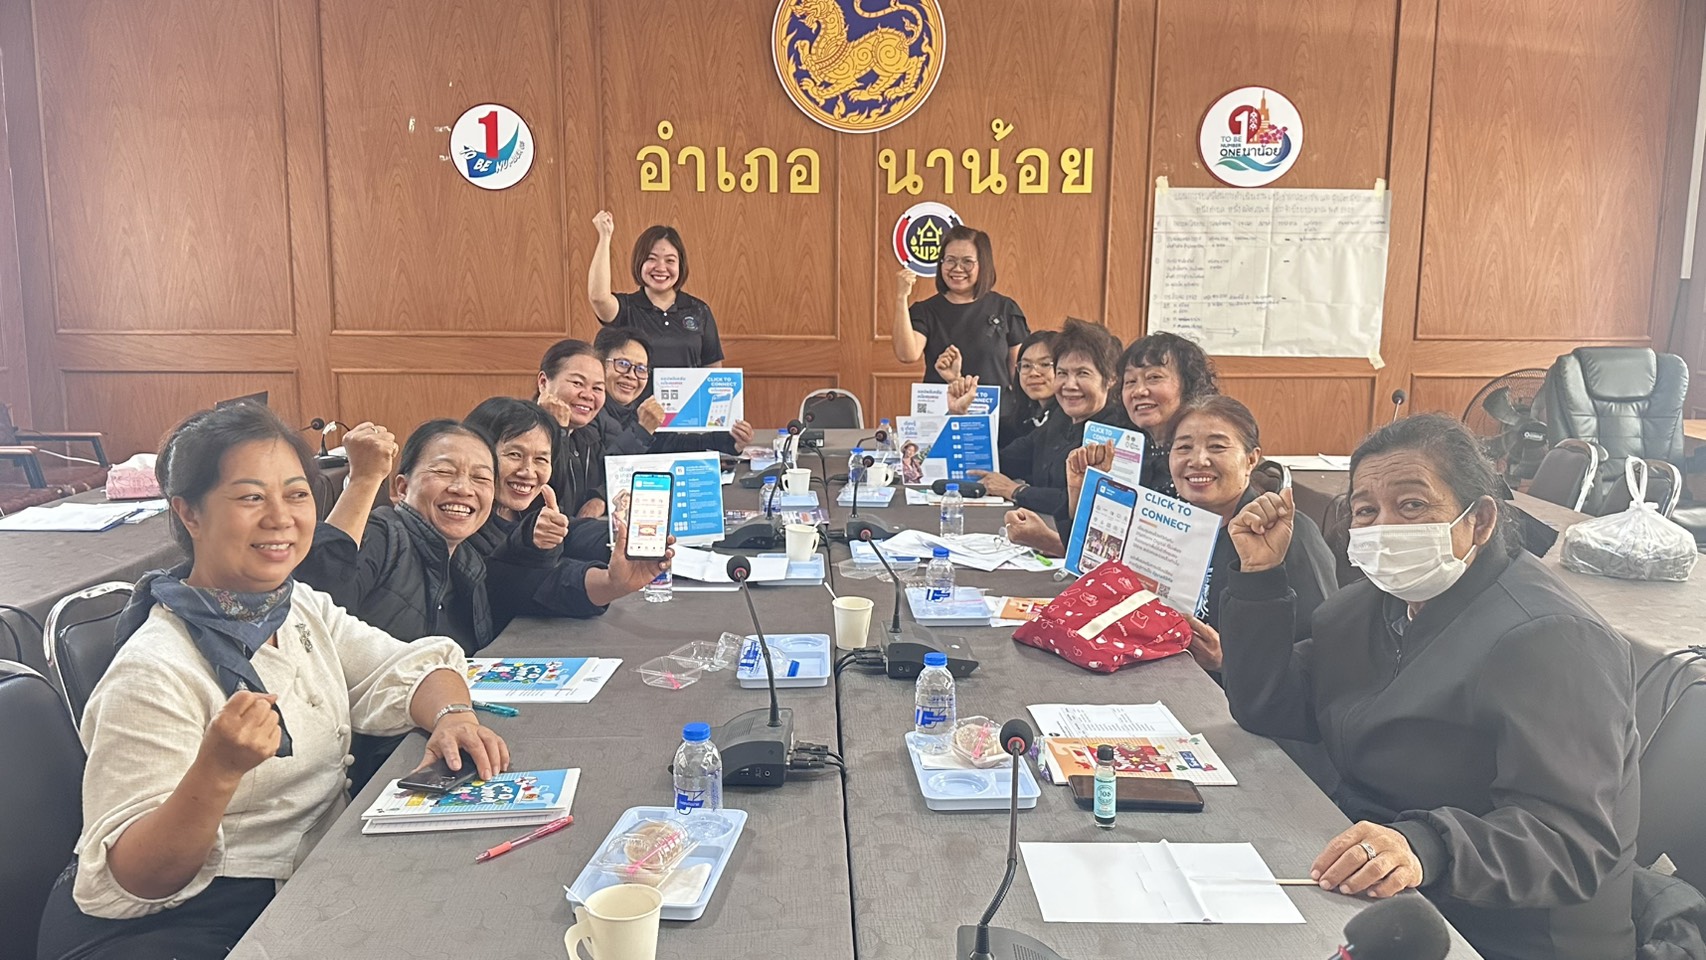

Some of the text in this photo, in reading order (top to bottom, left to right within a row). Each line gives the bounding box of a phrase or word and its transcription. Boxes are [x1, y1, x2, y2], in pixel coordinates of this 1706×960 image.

[478, 111, 498, 159] 1
[636, 118, 1095, 194] อำเภอ นาน้อย
[1220, 143, 1281, 157] ONE นาน้อย
[473, 158, 493, 173] BE
[1145, 492, 1192, 516] CLICK TO
[1141, 507, 1191, 533] CONNECT
